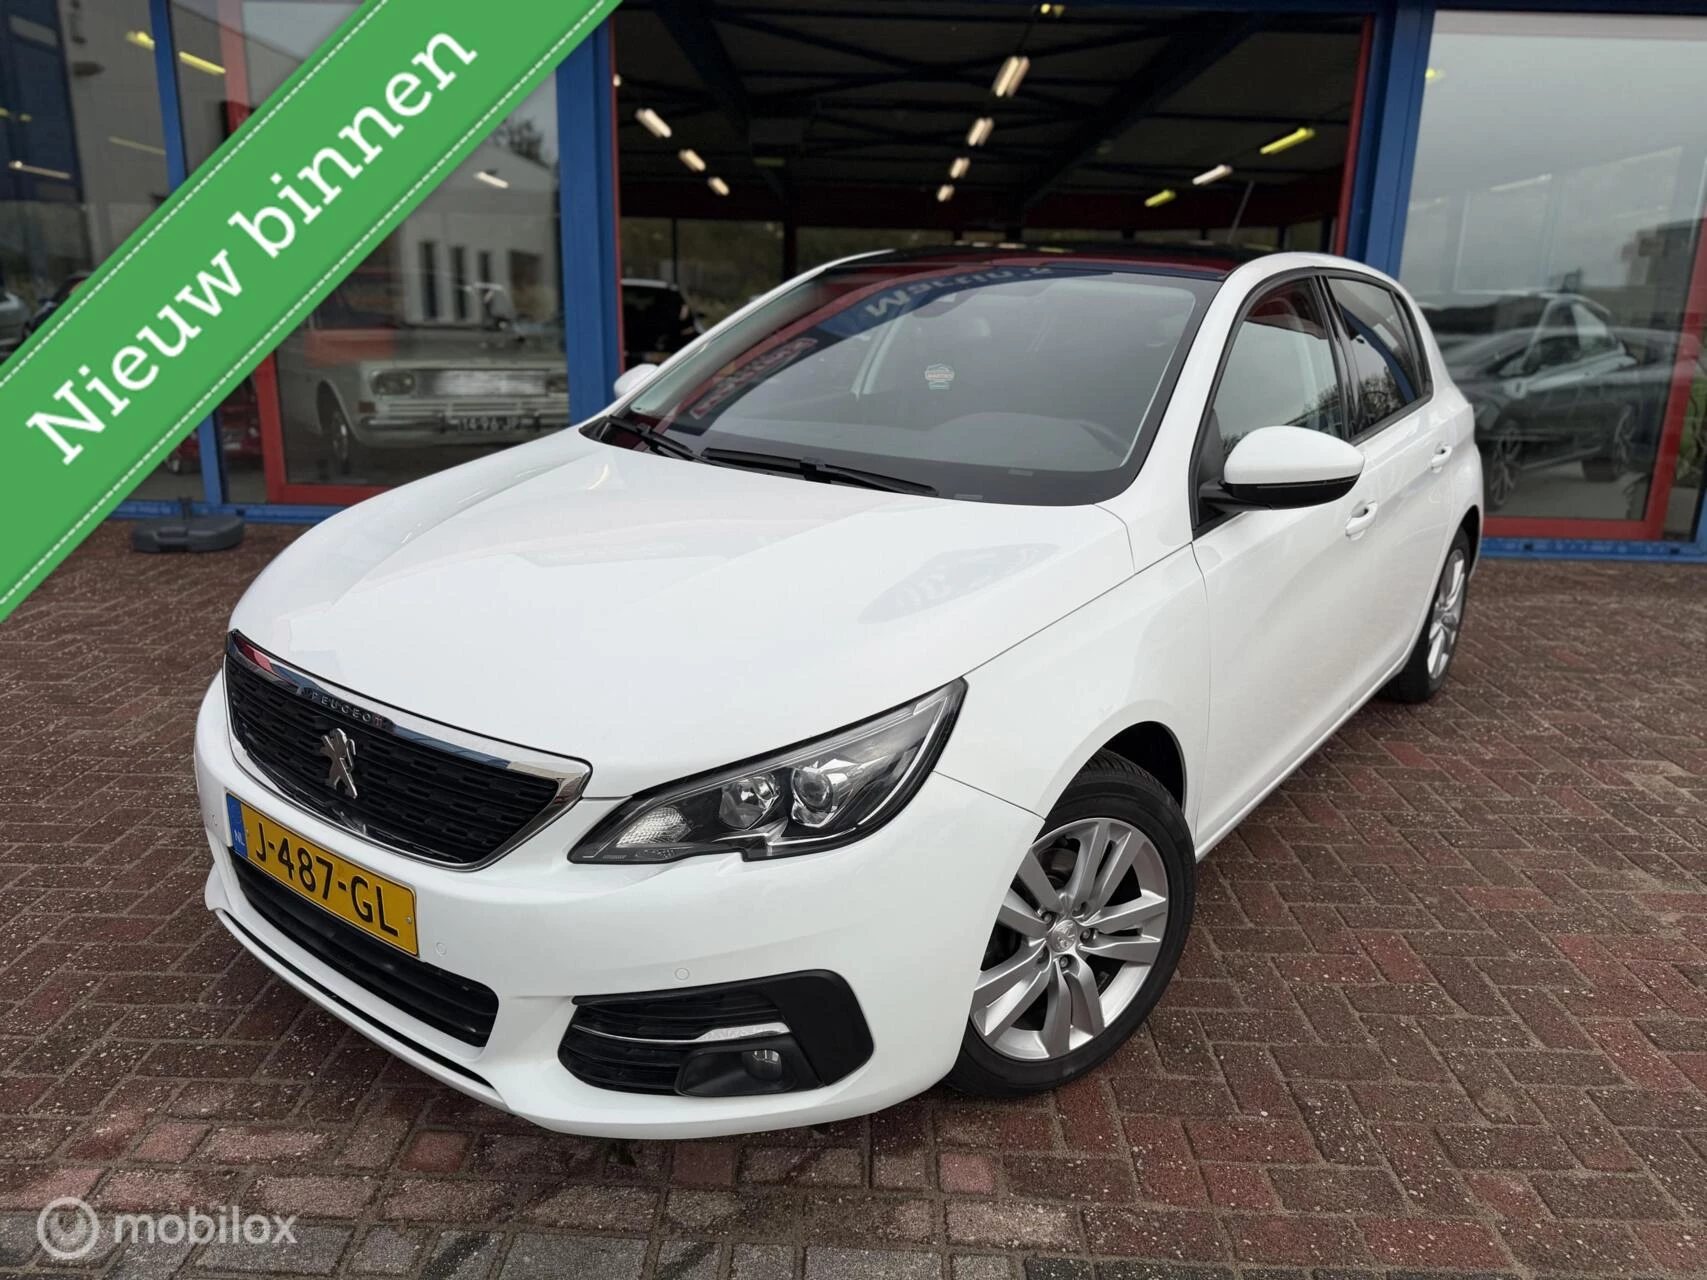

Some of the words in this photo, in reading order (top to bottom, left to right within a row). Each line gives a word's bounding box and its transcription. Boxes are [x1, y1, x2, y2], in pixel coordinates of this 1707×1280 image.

[311, 691, 383, 727] PEUGEOT
[233, 828, 246, 846] NL
[256, 822, 399, 937] J-487-GL
